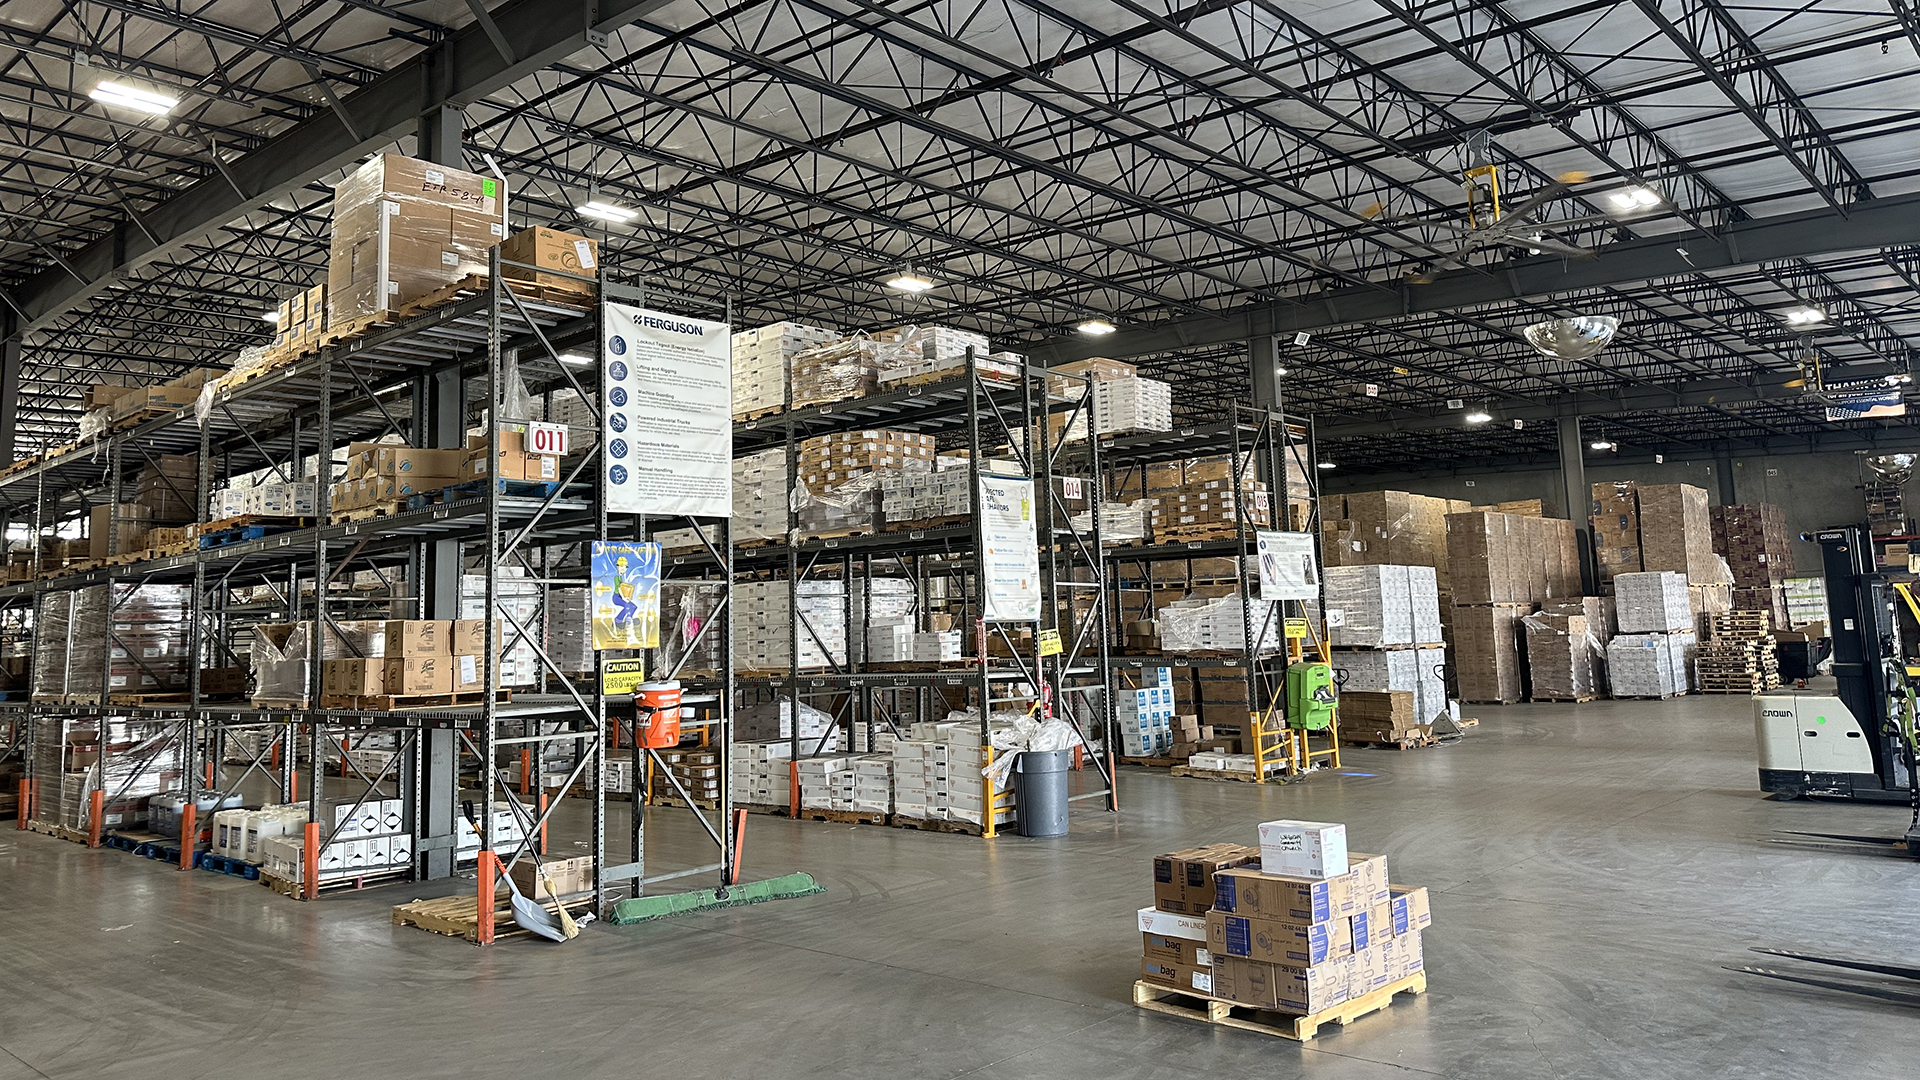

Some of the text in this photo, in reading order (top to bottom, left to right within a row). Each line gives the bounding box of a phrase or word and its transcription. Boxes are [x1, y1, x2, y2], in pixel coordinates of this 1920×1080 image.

[643, 316, 703, 336] FERGUSON
[535, 429, 563, 452] 011
[1065, 482, 1080, 497] 014
[1256, 495, 1267, 508] 015
[606, 663, 639, 672] CAUTION
[605, 681, 624, 689] 2500
[1761, 709, 1794, 718] CROWN
[1177, 919, 1190, 928] CAN
[1281, 965, 1290, 973] 29
[1290, 966, 1298, 974] 00
